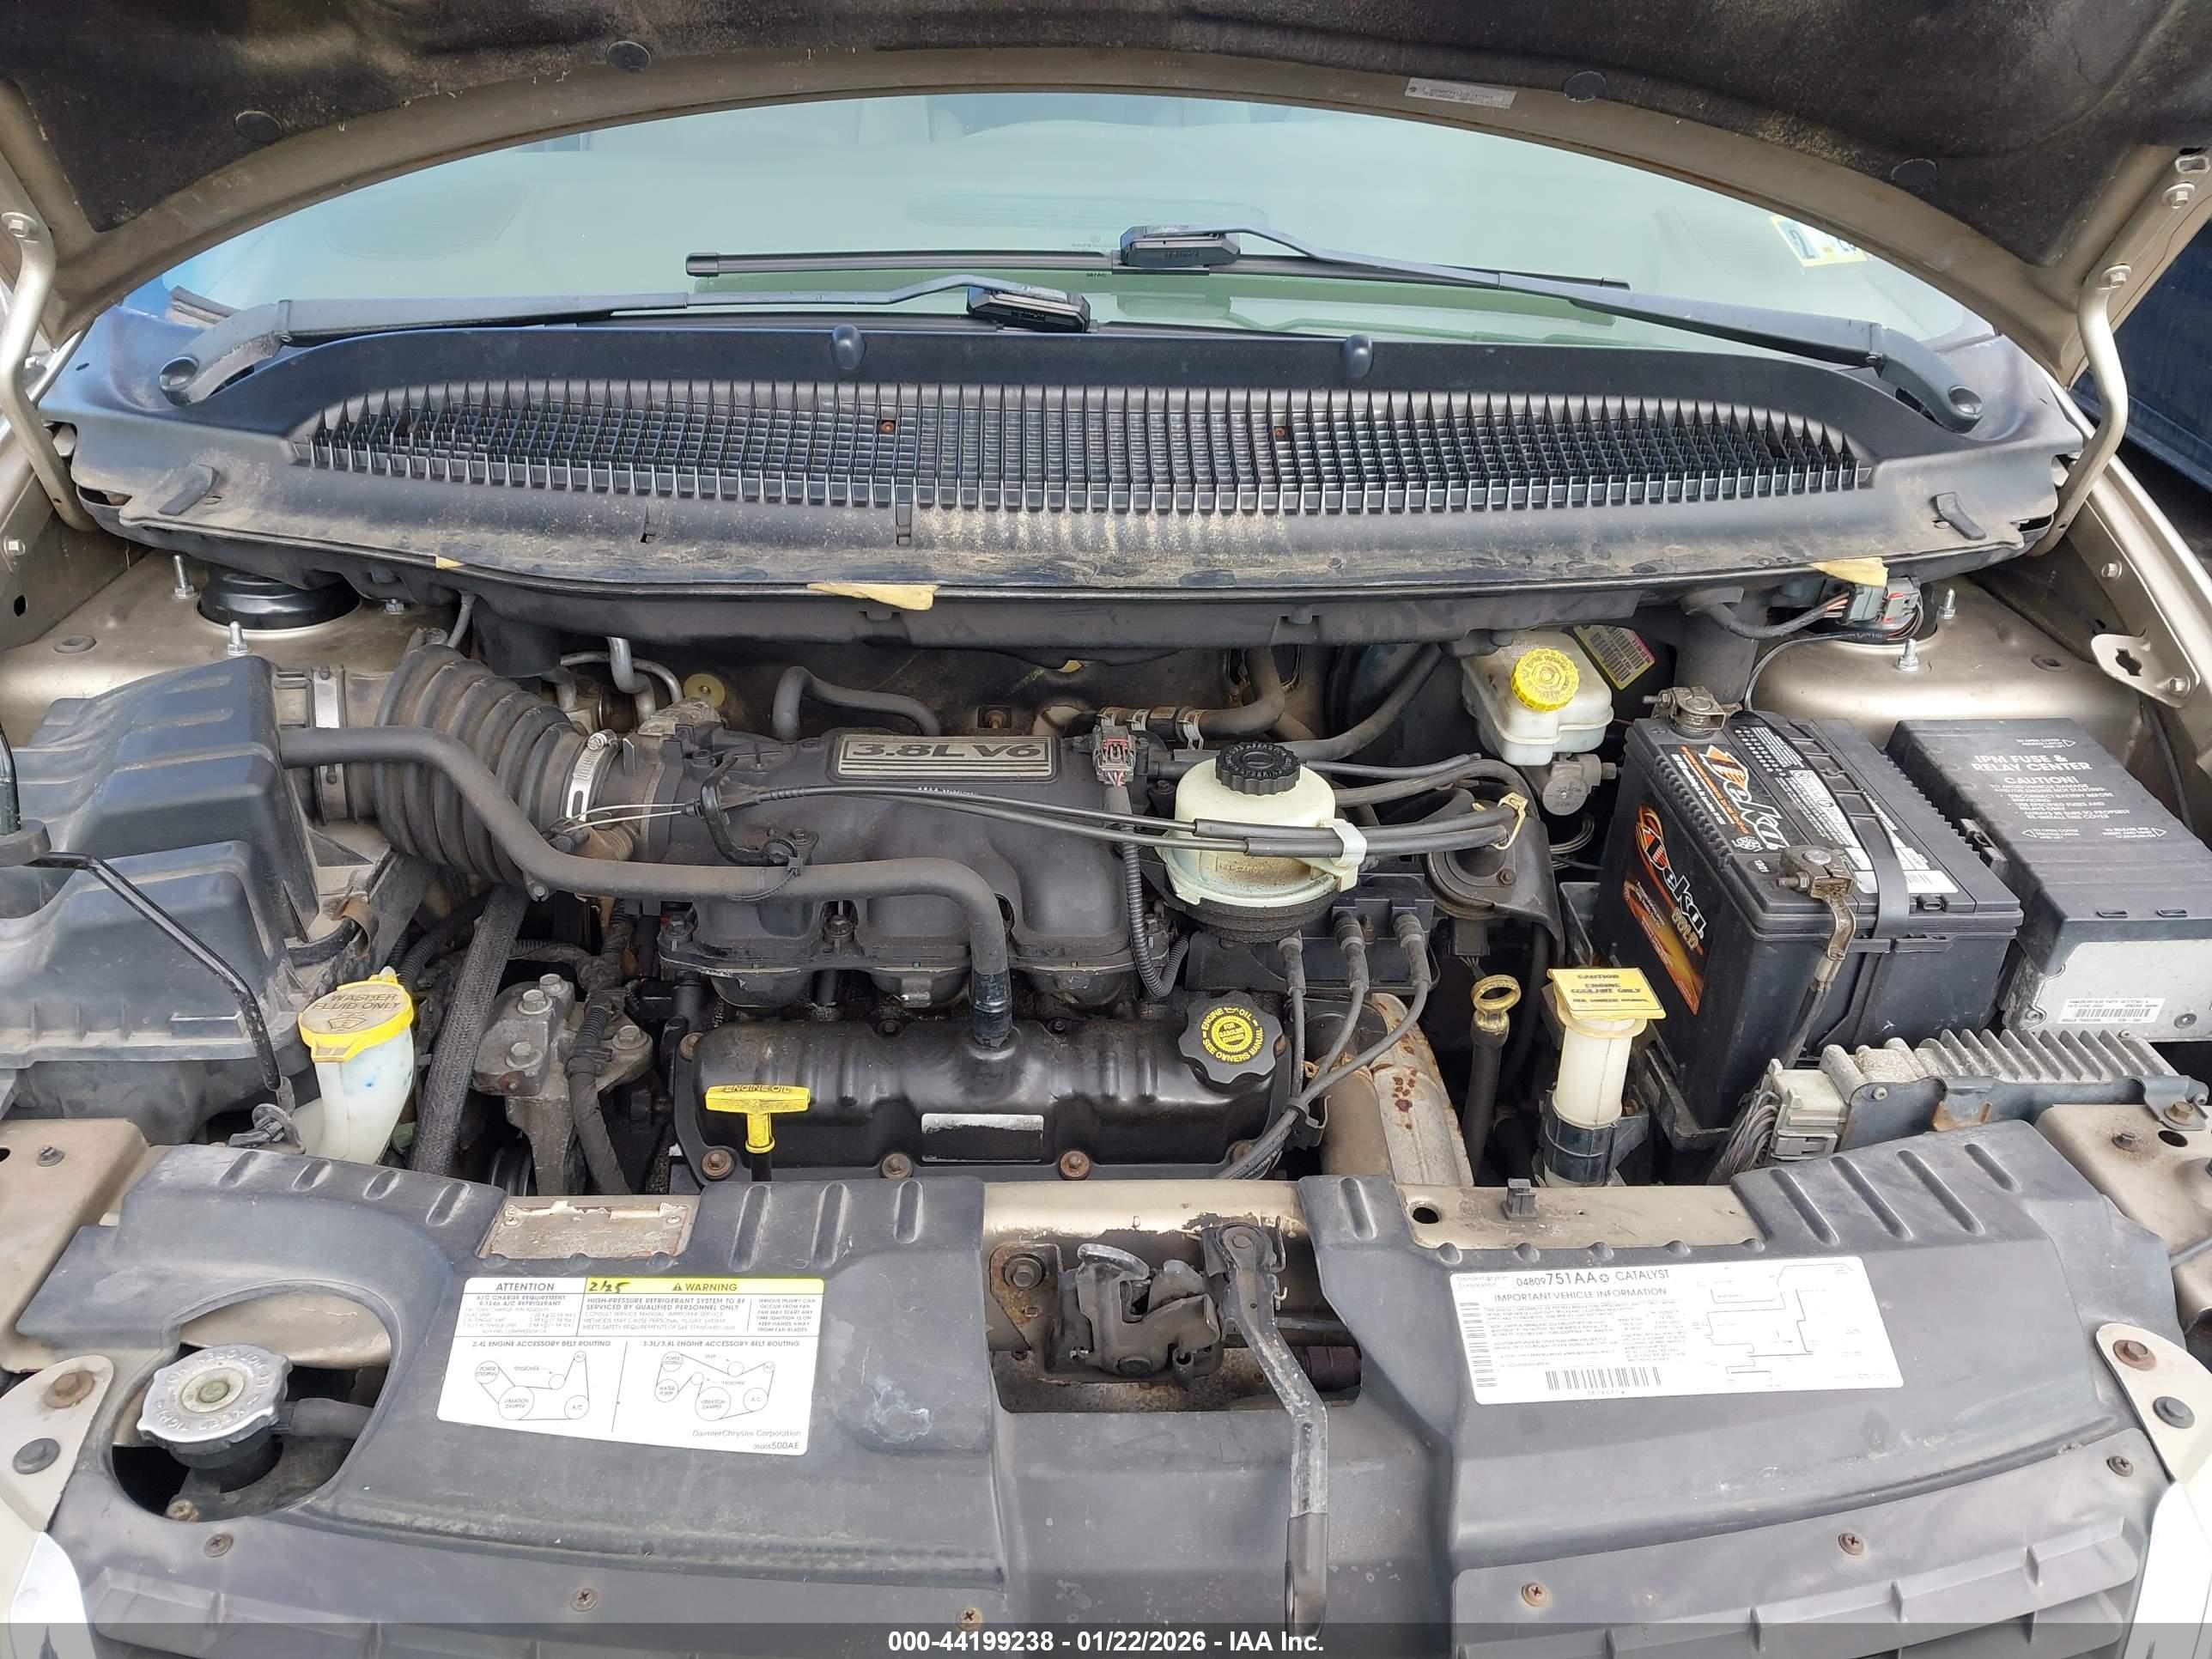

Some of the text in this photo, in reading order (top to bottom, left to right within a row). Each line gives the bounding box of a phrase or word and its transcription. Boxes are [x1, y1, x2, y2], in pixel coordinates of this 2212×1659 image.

[853, 744, 1041, 757] 3.8L V6
[1971, 763, 2093, 771] RELAY CENTER
[1698, 744, 1790, 848] Deka
[1644, 827, 1707, 933] Deka
[1671, 907, 1699, 951] GOLD
[1201, 1007, 1252, 1030] ENGINE OIL
[1203, 1027, 1263, 1062] SEE OWNERS MANUAL
[685, 1283, 737, 1291] WARNING
[1516, 1270, 1670, 1287] 04809751AA CATALYST
[1494, 1288, 1667, 1302] IMPORTANT VEHICLE INFORMATION
[757, 1430, 801, 1438] Corporation
